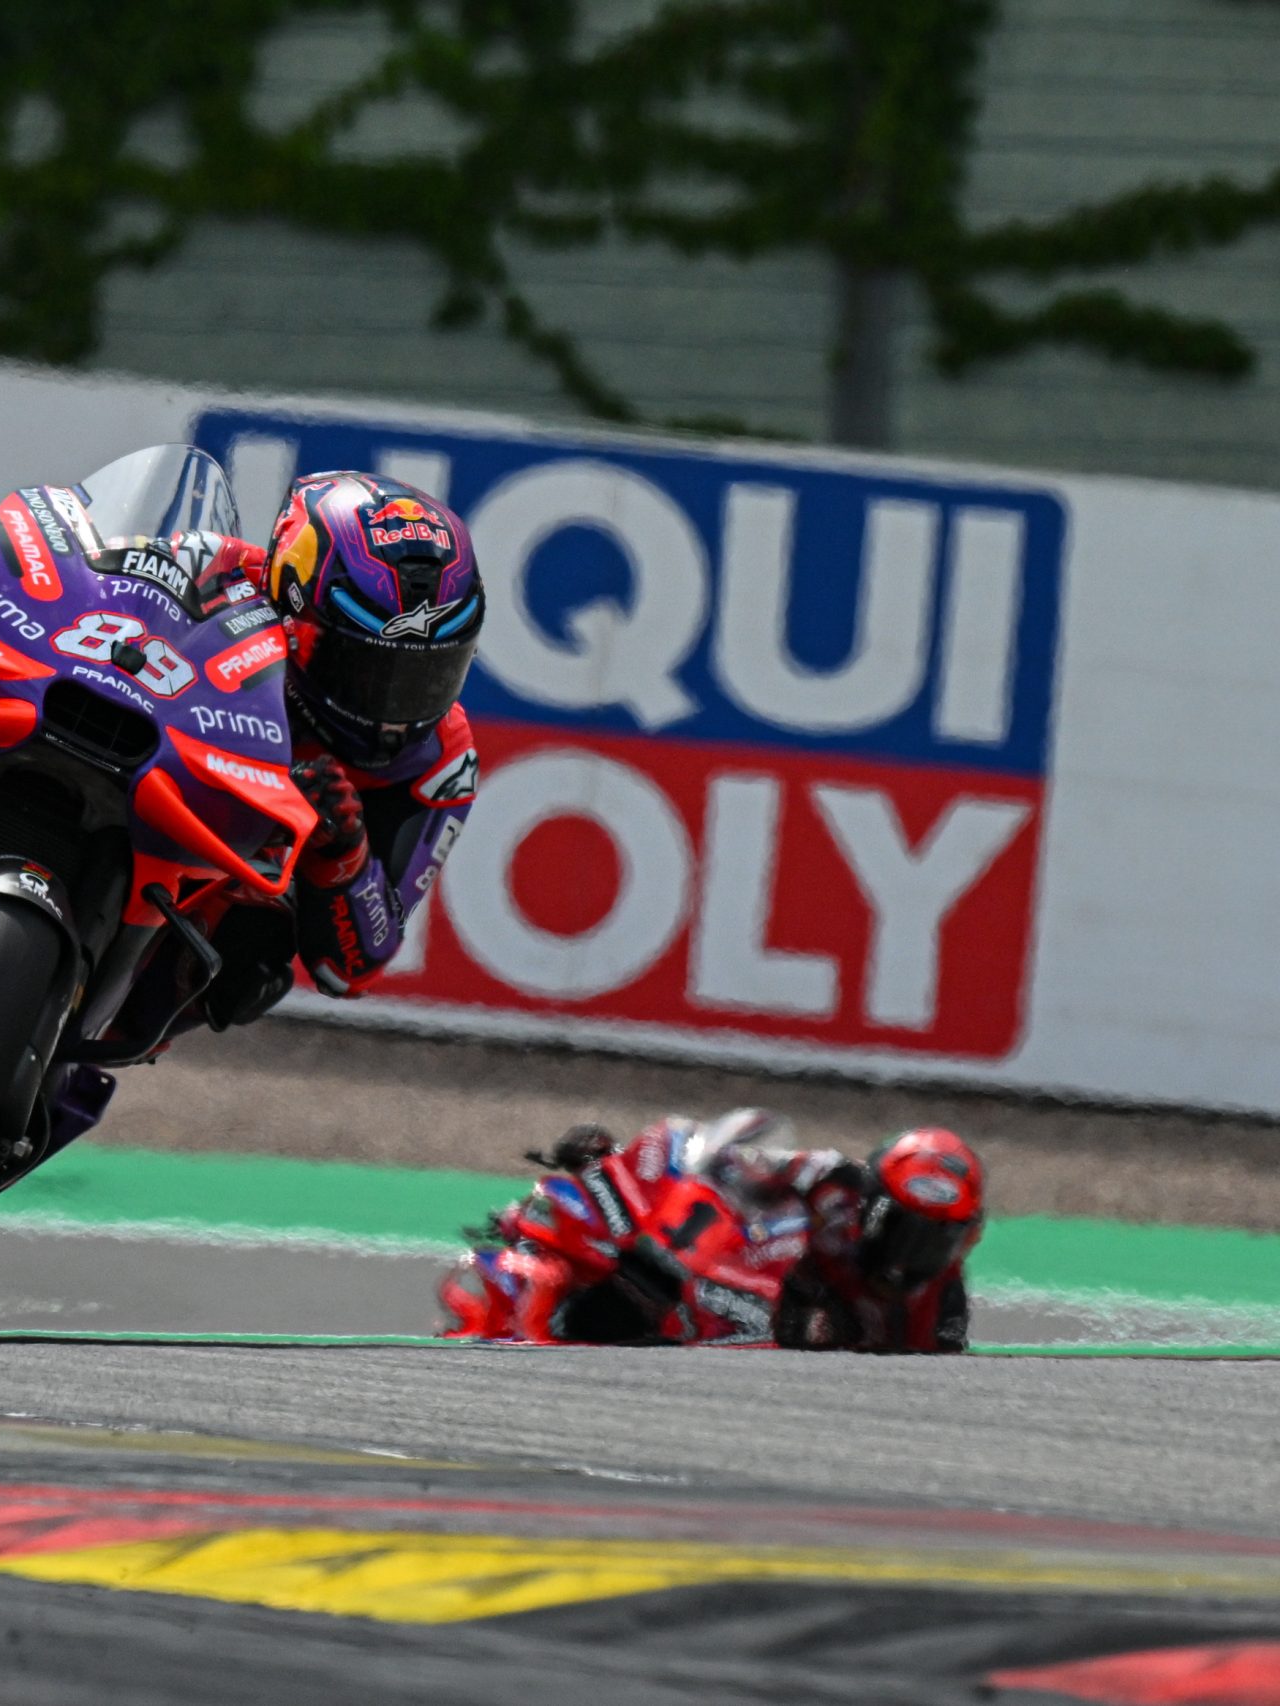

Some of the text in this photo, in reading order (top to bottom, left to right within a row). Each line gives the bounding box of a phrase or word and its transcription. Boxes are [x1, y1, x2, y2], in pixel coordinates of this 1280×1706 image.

[3, 509, 51, 586] PRAMAC
[123, 551, 189, 597] FIAMM
[226, 431, 1026, 744] QUI
[111, 580, 180, 621] prima
[50, 611, 198, 699] 89
[218, 637, 284, 679] PRAMAC
[73, 665, 155, 715] PRAMAC
[191, 705, 283, 744] prima
[207, 753, 285, 790] MOTUL
[382, 745, 1033, 1032] OLY
